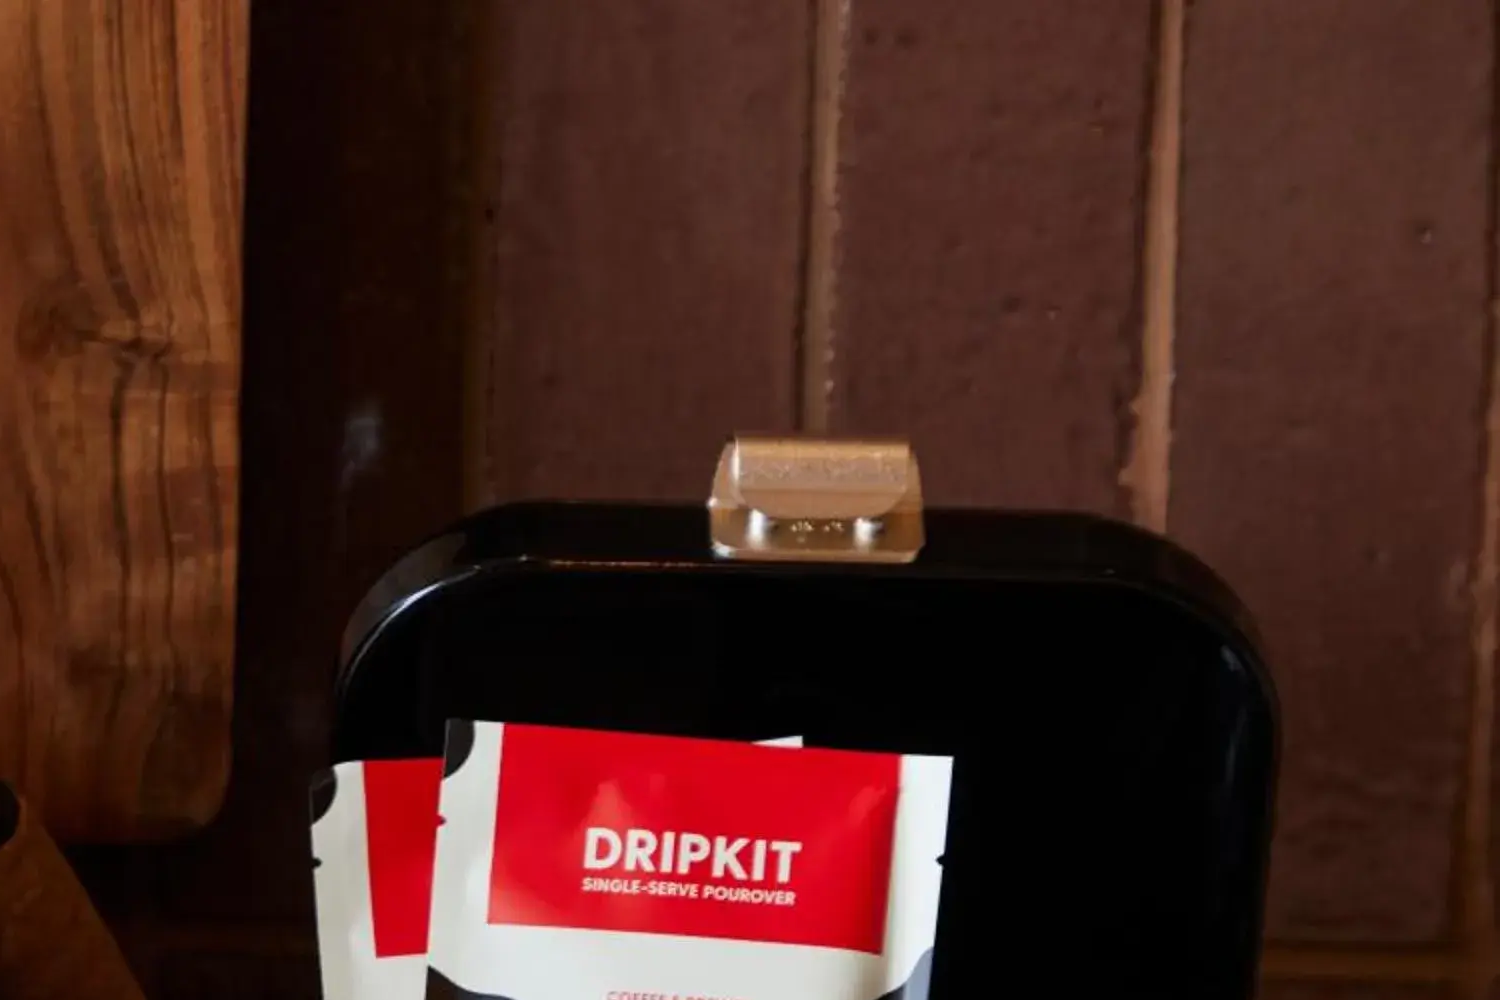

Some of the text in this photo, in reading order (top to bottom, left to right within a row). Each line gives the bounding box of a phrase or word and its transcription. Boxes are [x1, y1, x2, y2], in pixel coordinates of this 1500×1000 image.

[583, 827, 803, 884] DRIPKIT
[581, 877, 797, 907] SINGLE-SERVE POUROVER
